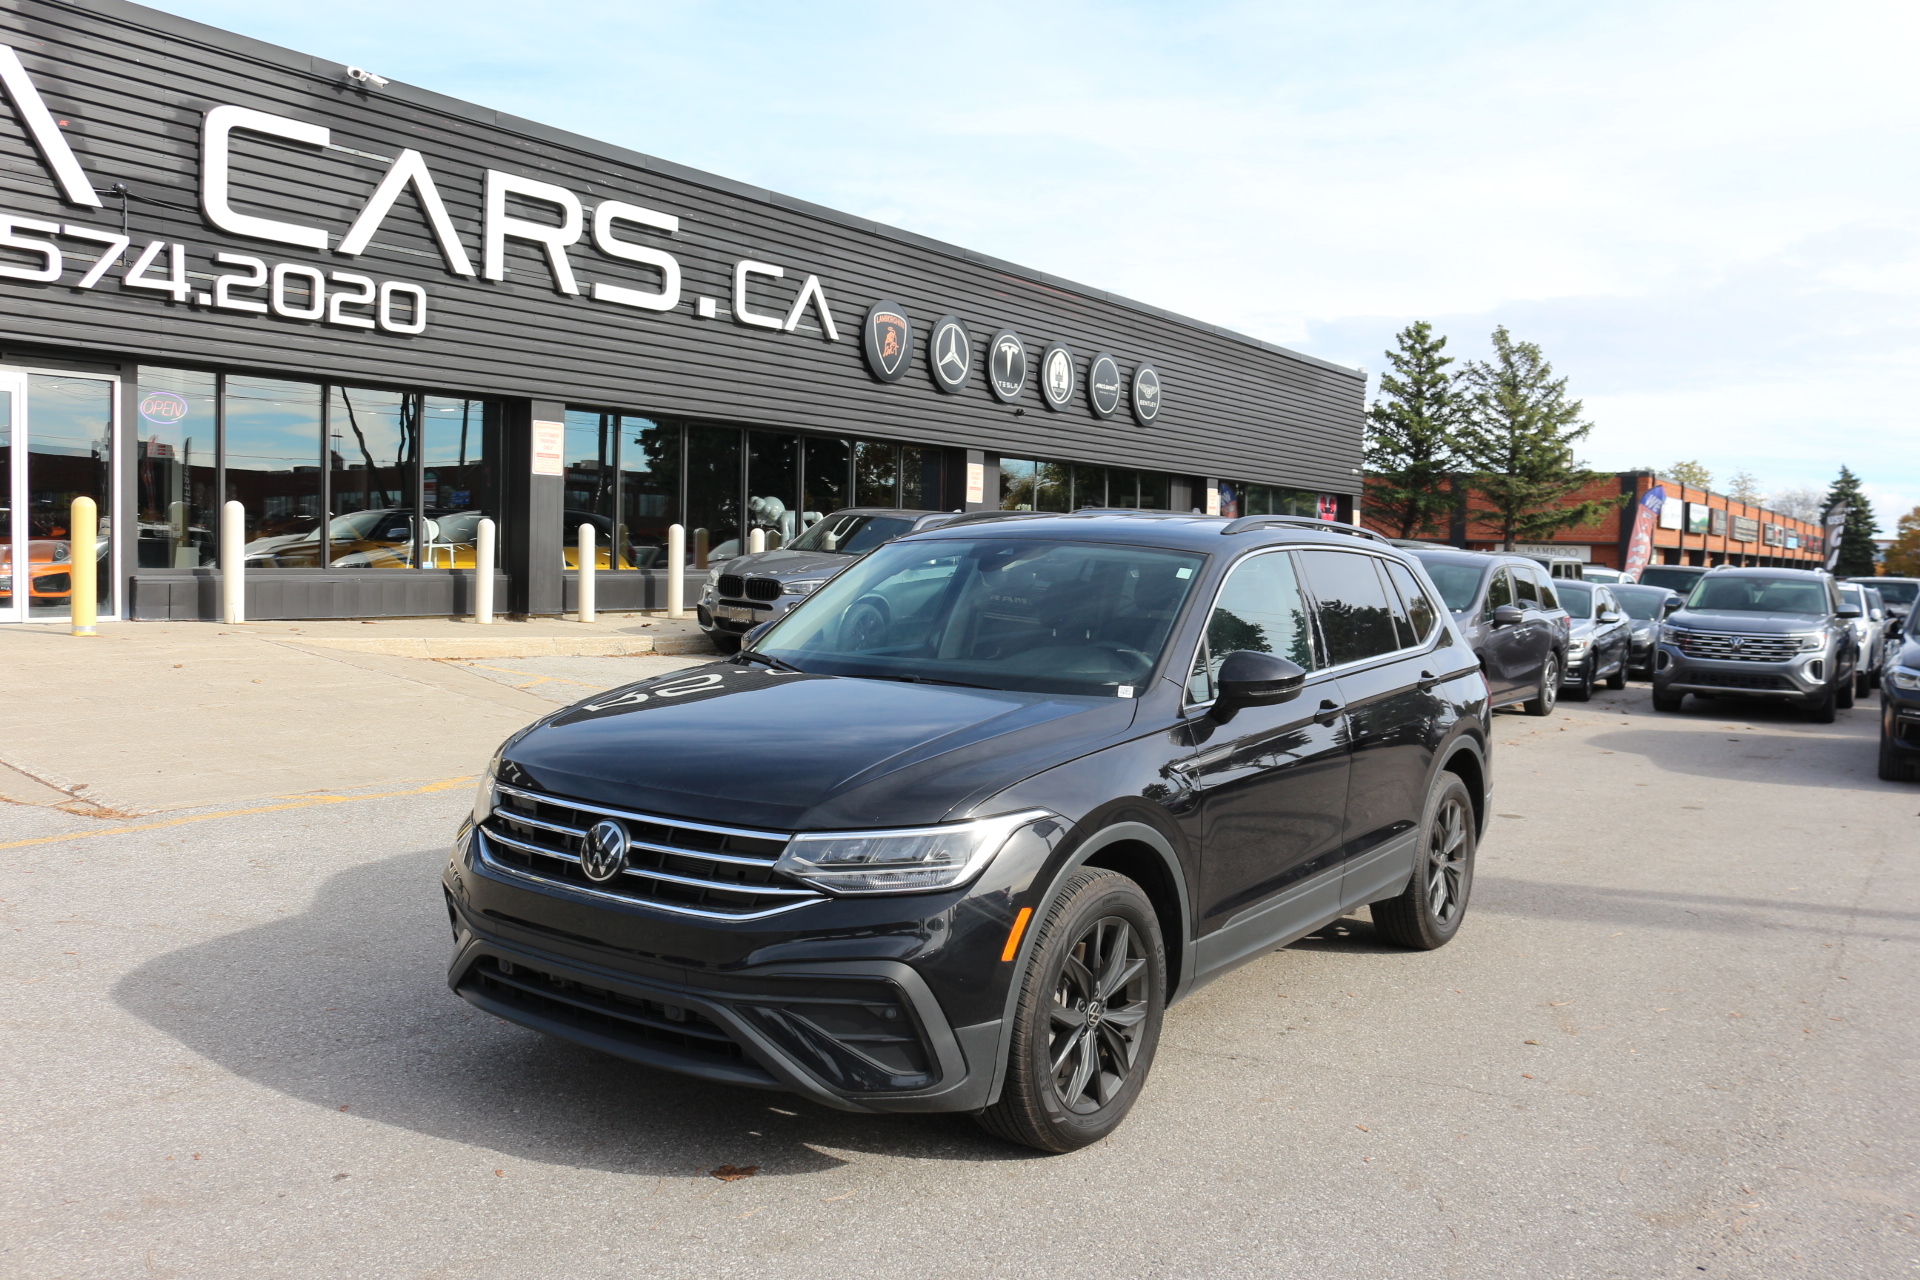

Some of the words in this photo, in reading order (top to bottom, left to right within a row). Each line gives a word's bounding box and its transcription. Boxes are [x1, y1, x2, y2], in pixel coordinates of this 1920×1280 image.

[876, 314, 905, 330] LAMBORGHINI
[998, 380, 1019, 389] TESLA
[142, 399, 183, 416] OPEN
[1139, 399, 1157, 408] BENTLEY
[1645, 493, 1663, 513] WE
[1527, 546, 1579, 557] BAMBOO
